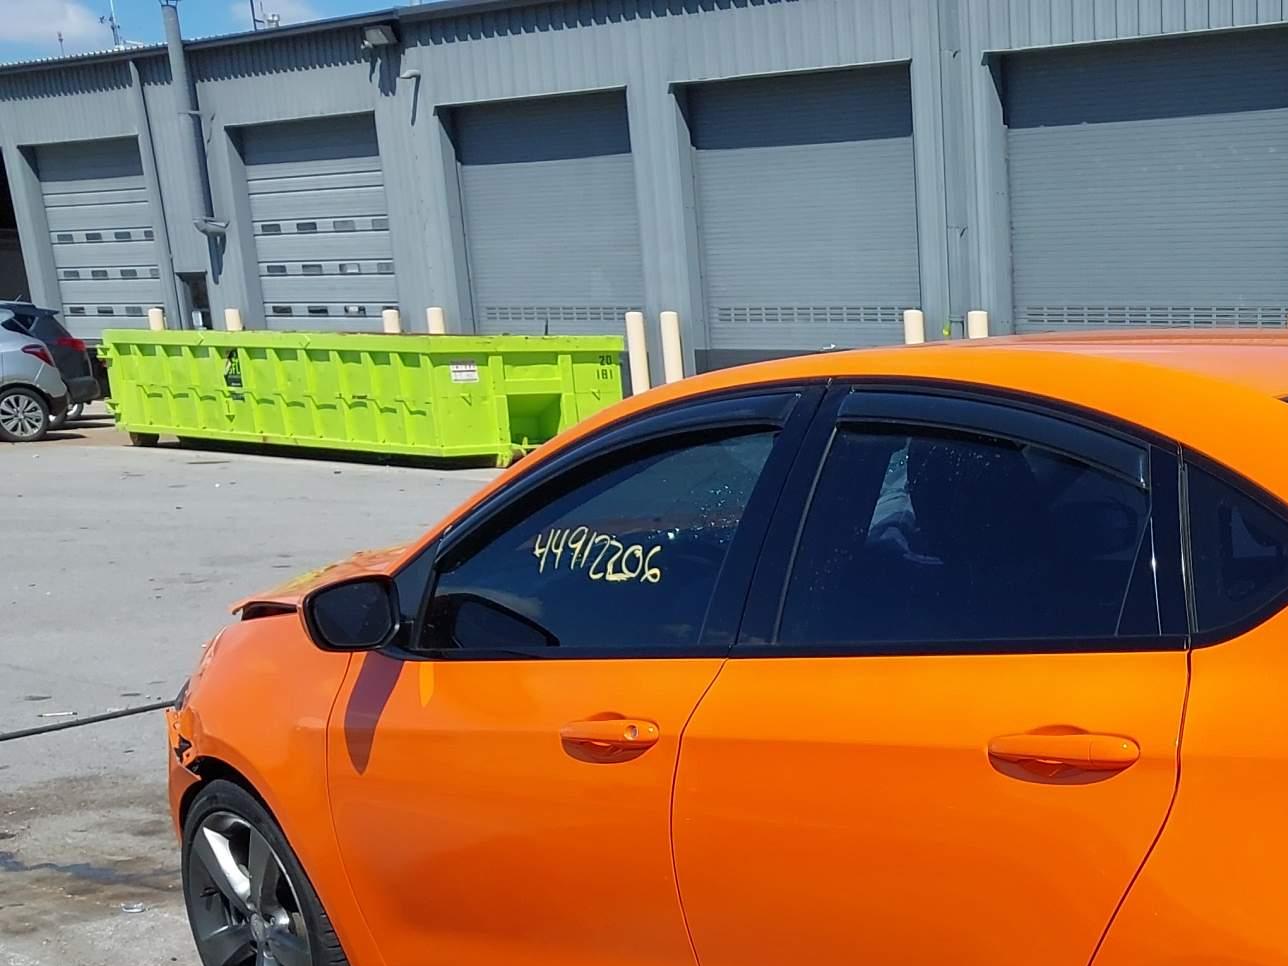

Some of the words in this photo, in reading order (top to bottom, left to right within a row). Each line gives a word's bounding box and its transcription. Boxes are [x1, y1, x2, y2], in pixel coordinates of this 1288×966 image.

[600, 355, 612, 365] 20
[597, 368, 613, 380] 181
[534, 526, 661, 582] 44912206
